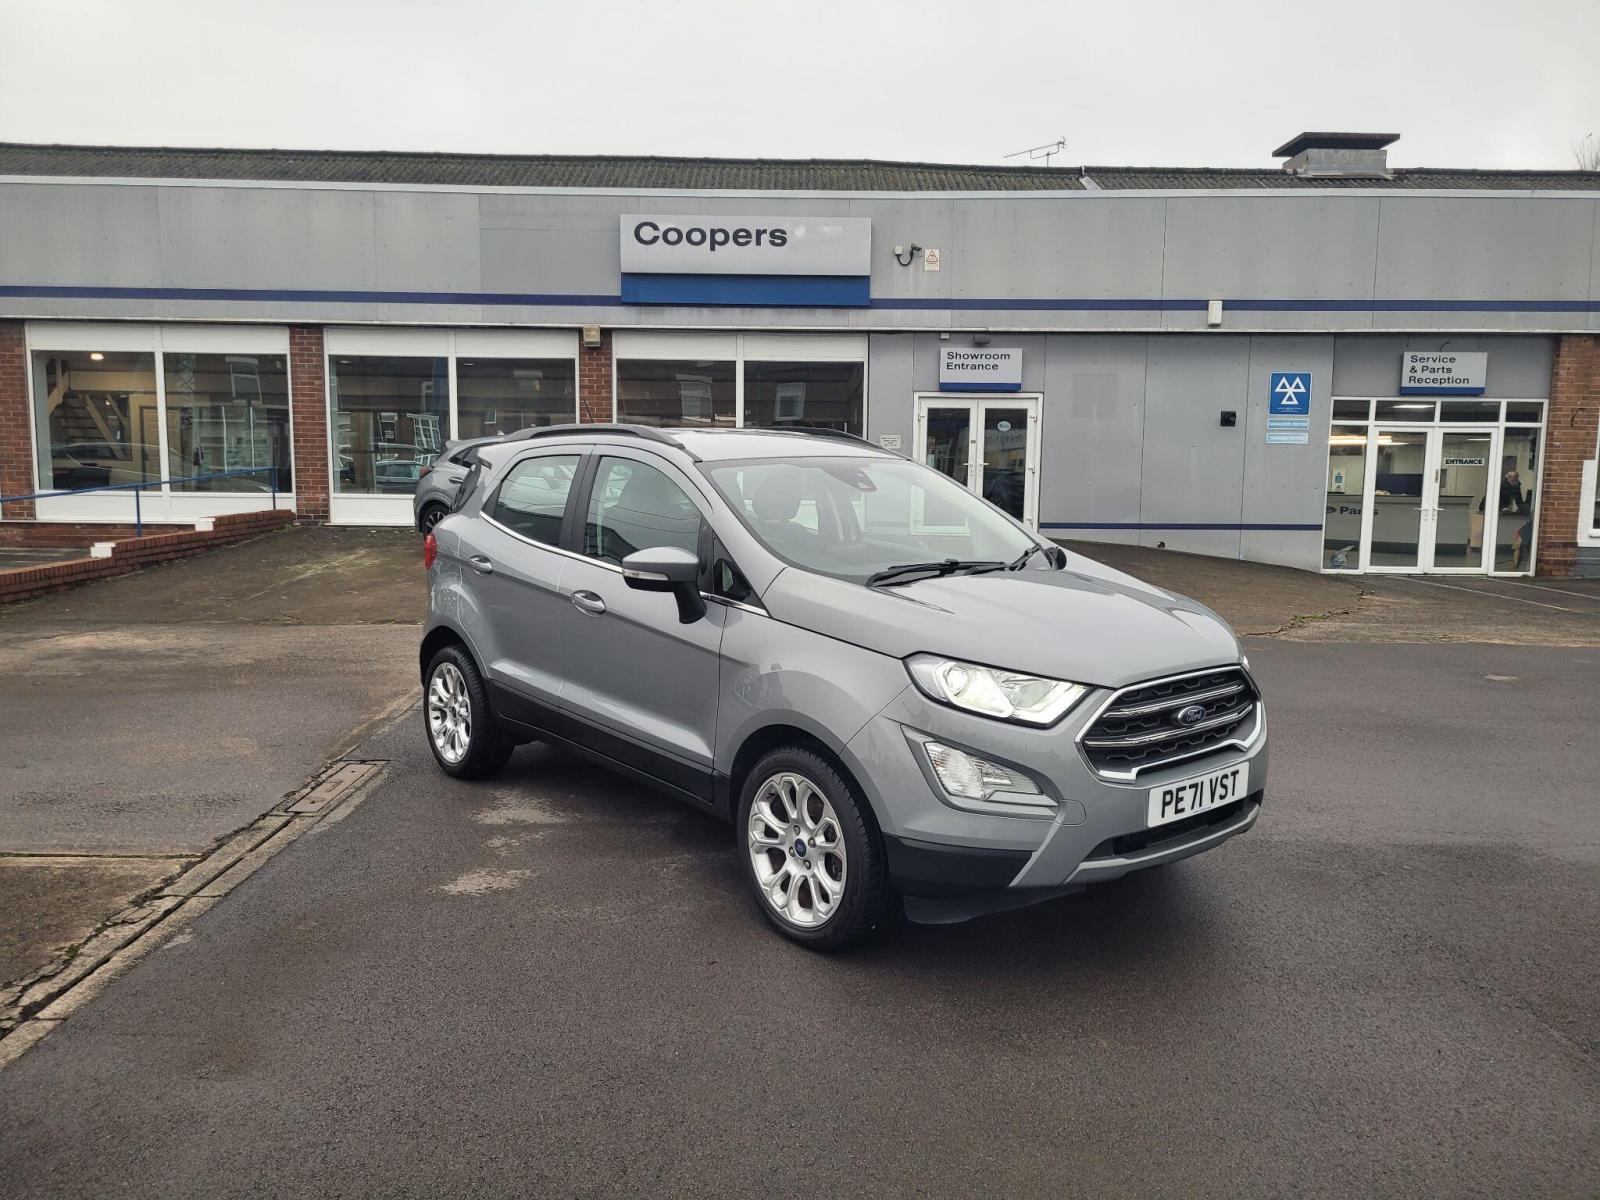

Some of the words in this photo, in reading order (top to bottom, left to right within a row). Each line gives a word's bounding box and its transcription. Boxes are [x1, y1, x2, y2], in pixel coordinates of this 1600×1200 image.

[633, 221, 788, 252] Coopers
[947, 351, 1011, 360] Showroom
[1410, 355, 1456, 364] Service
[946, 362, 999, 371] Entrance
[1409, 365, 1418, 374] &
[1421, 365, 1453, 374] Parts
[1408, 375, 1470, 386] Reception
[1339, 505, 1379, 516] Pars
[1161, 780, 1205, 819] PE71
[1208, 769, 1240, 804] VST
